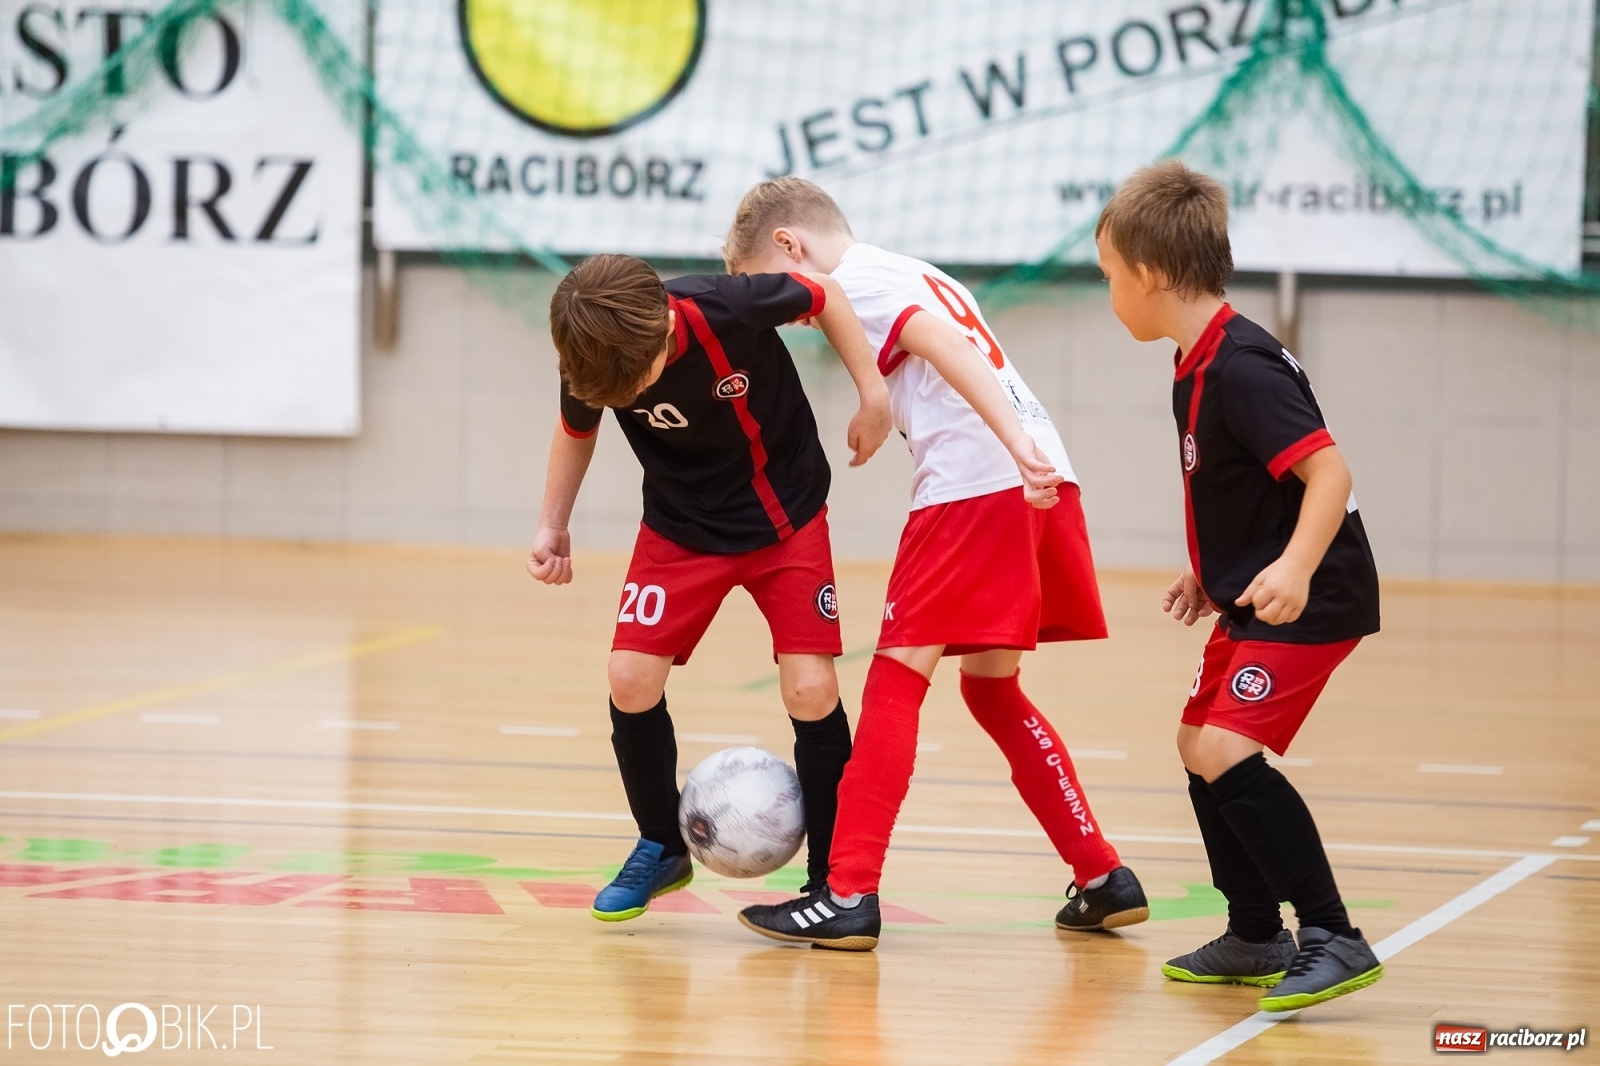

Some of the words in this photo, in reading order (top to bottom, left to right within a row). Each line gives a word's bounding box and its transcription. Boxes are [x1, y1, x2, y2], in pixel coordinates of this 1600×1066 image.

[765, 80, 934, 179] JEST
[960, 53, 1027, 119] W
[0, 123, 320, 243] BÓRZ
[451, 151, 707, 199] RACIBÓRZ
[922, 273, 1005, 370] 9
[633, 402, 689, 430] 20
[617, 582, 667, 626] 20
[1023, 716, 1053, 750] UKS
[1045, 752, 1095, 837] CIESZYN
